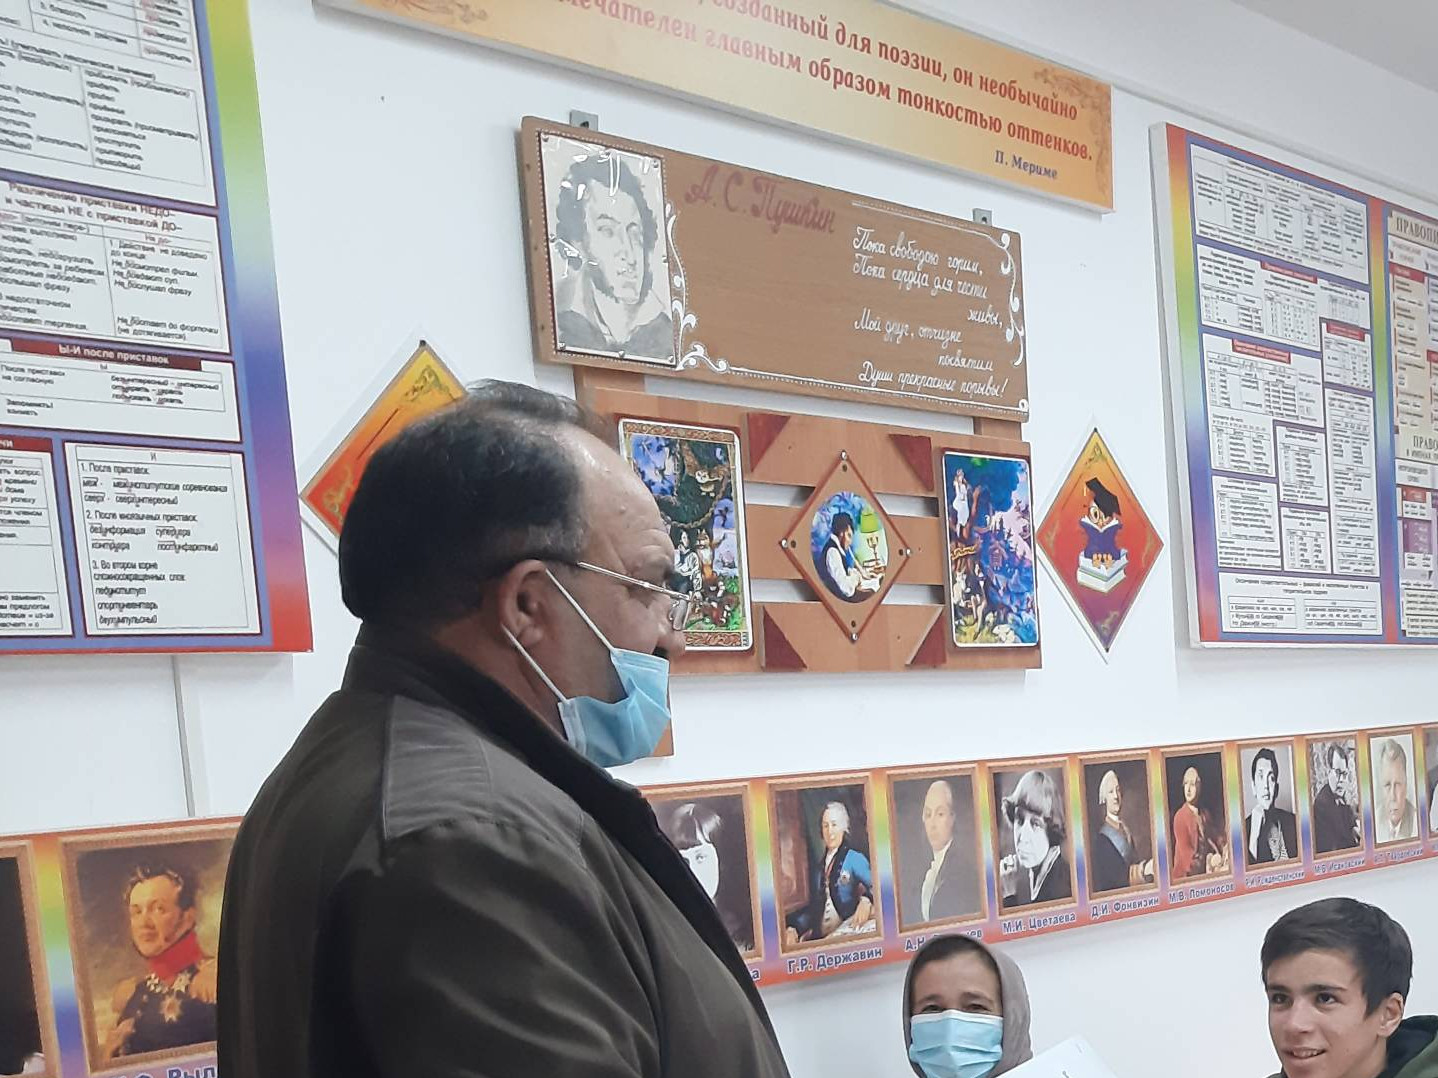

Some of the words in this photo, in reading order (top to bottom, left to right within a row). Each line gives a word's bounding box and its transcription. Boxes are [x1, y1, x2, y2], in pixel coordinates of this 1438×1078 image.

[835, 22, 872, 54] для
[878, 43, 949, 83] поэзии,
[953, 62, 974, 89] он
[979, 73, 1078, 121] необычайно
[705, 29, 801, 73] главным
[808, 58, 891, 101] образом
[897, 87, 1002, 134] тонкостью
[1007, 120, 1093, 162] оттенков.
[994, 150, 1009, 166] П.
[1012, 156, 1058, 180] Мериме
[751, 175, 835, 234] Пушкин
[853, 226, 886, 254] Пока
[890, 232, 939, 271] свободою
[853, 253, 885, 279] Пока
[892, 268, 929, 290] сердца
[931, 276, 953, 296] для
[957, 280, 988, 299] чести
[854, 308, 881, 332] Мой
[918, 325, 962, 349] отчизне
[967, 304, 1003, 329] живы,
[58, 343, 81, 354] Ы-И
[83, 349, 115, 359] после
[117, 351, 169, 364] приставок
[938, 349, 994, 371] посвятим
[858, 360, 893, 387] Души
[898, 372, 956, 392] прекрасные
[960, 375, 1009, 398] порывы!
[1114, 898, 1159, 912] Фонвизин
[1190, 885, 1234, 899] Ломоносов
[1003, 919, 1026, 933] М.И.
[1029, 913, 1076, 929] Цветаева
[788, 958, 813, 973] Г.Р.
[817, 949, 882, 969] Державин
